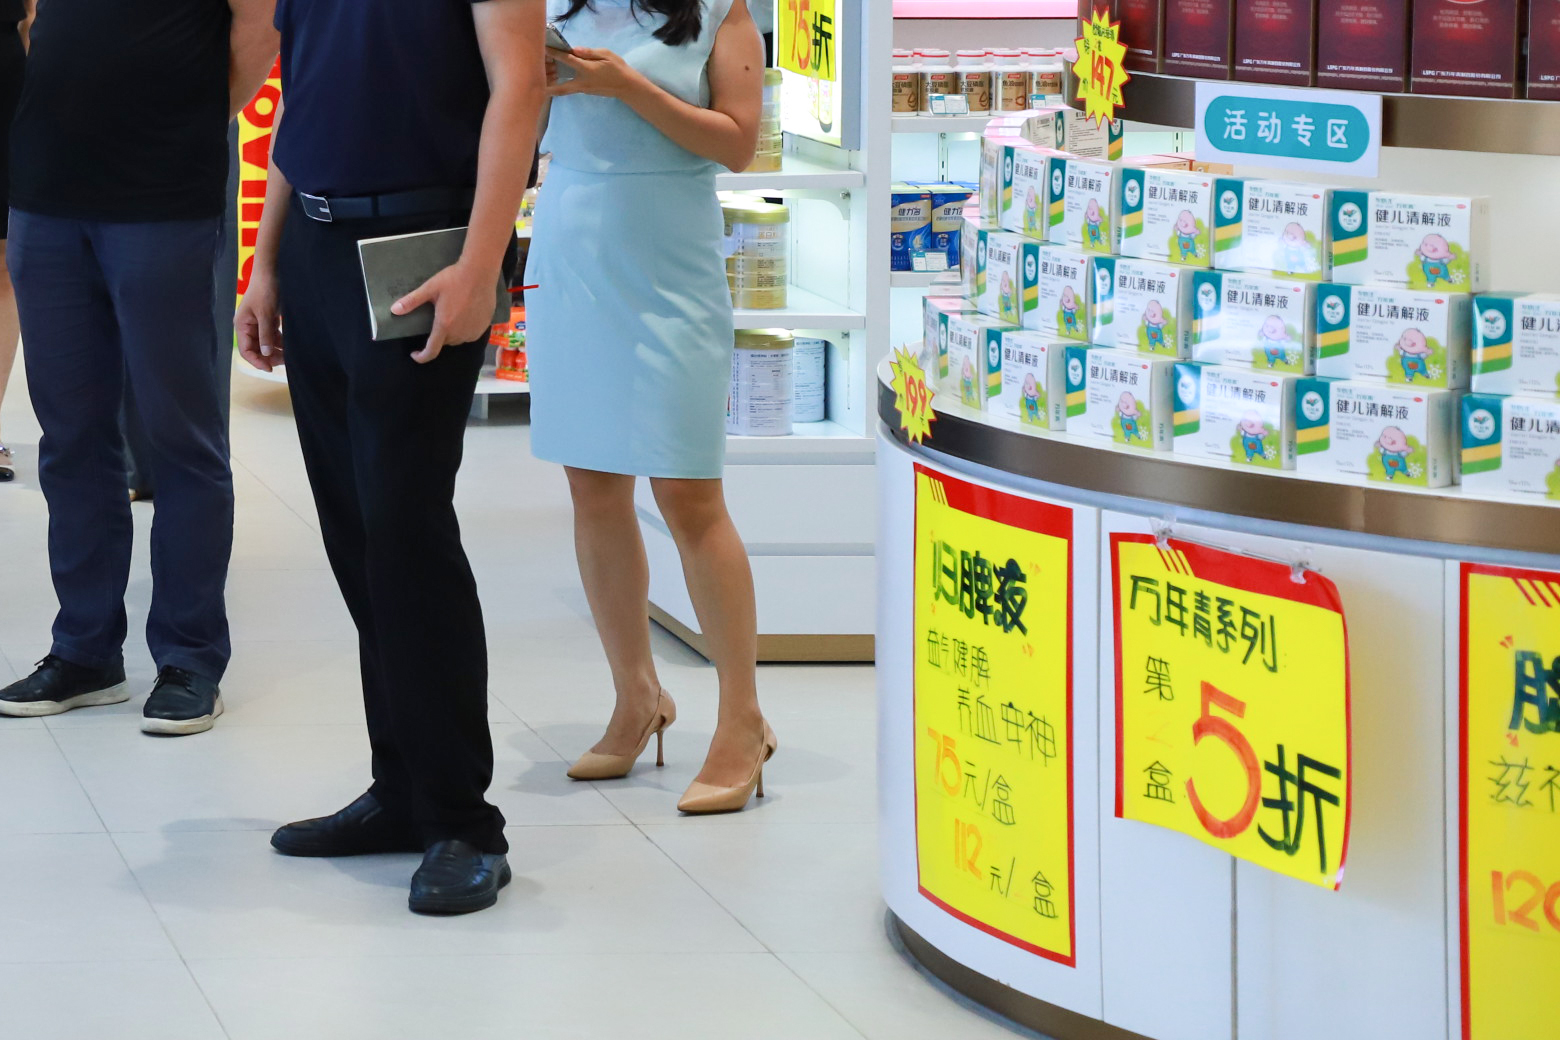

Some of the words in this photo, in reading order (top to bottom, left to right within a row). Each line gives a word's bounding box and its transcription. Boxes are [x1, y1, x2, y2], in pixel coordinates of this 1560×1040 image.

[1092, 50, 1114, 100] 147
[1223, 108, 1349, 149] 活动专区
[1068, 175, 1102, 193] 健儿清解液
[1148, 186, 1198, 205] 健儿清解液
[1249, 197, 1308, 216] 健儿清解液
[1375, 209, 1452, 228] 健儿清解液
[1041, 262, 1077, 280] 健儿清解液
[1119, 275, 1166, 294] 健儿清解液
[1227, 289, 1288, 309] 健儿清解液
[1357, 302, 1430, 322] 健儿清解液
[1521, 315, 1560, 332] 健儿
[1004, 349, 1038, 368] 健儿清解液
[1091, 365, 1138, 386] 健儿清解液
[904, 372, 927, 417] 199
[1206, 382, 1266, 403] 健儿清解液
[1337, 399, 1408, 420] 健儿清解液
[933, 538, 1028, 637] 归脾液
[1129, 575, 1278, 674] 万年青系列
[1186, 679, 1341, 874] 5折
